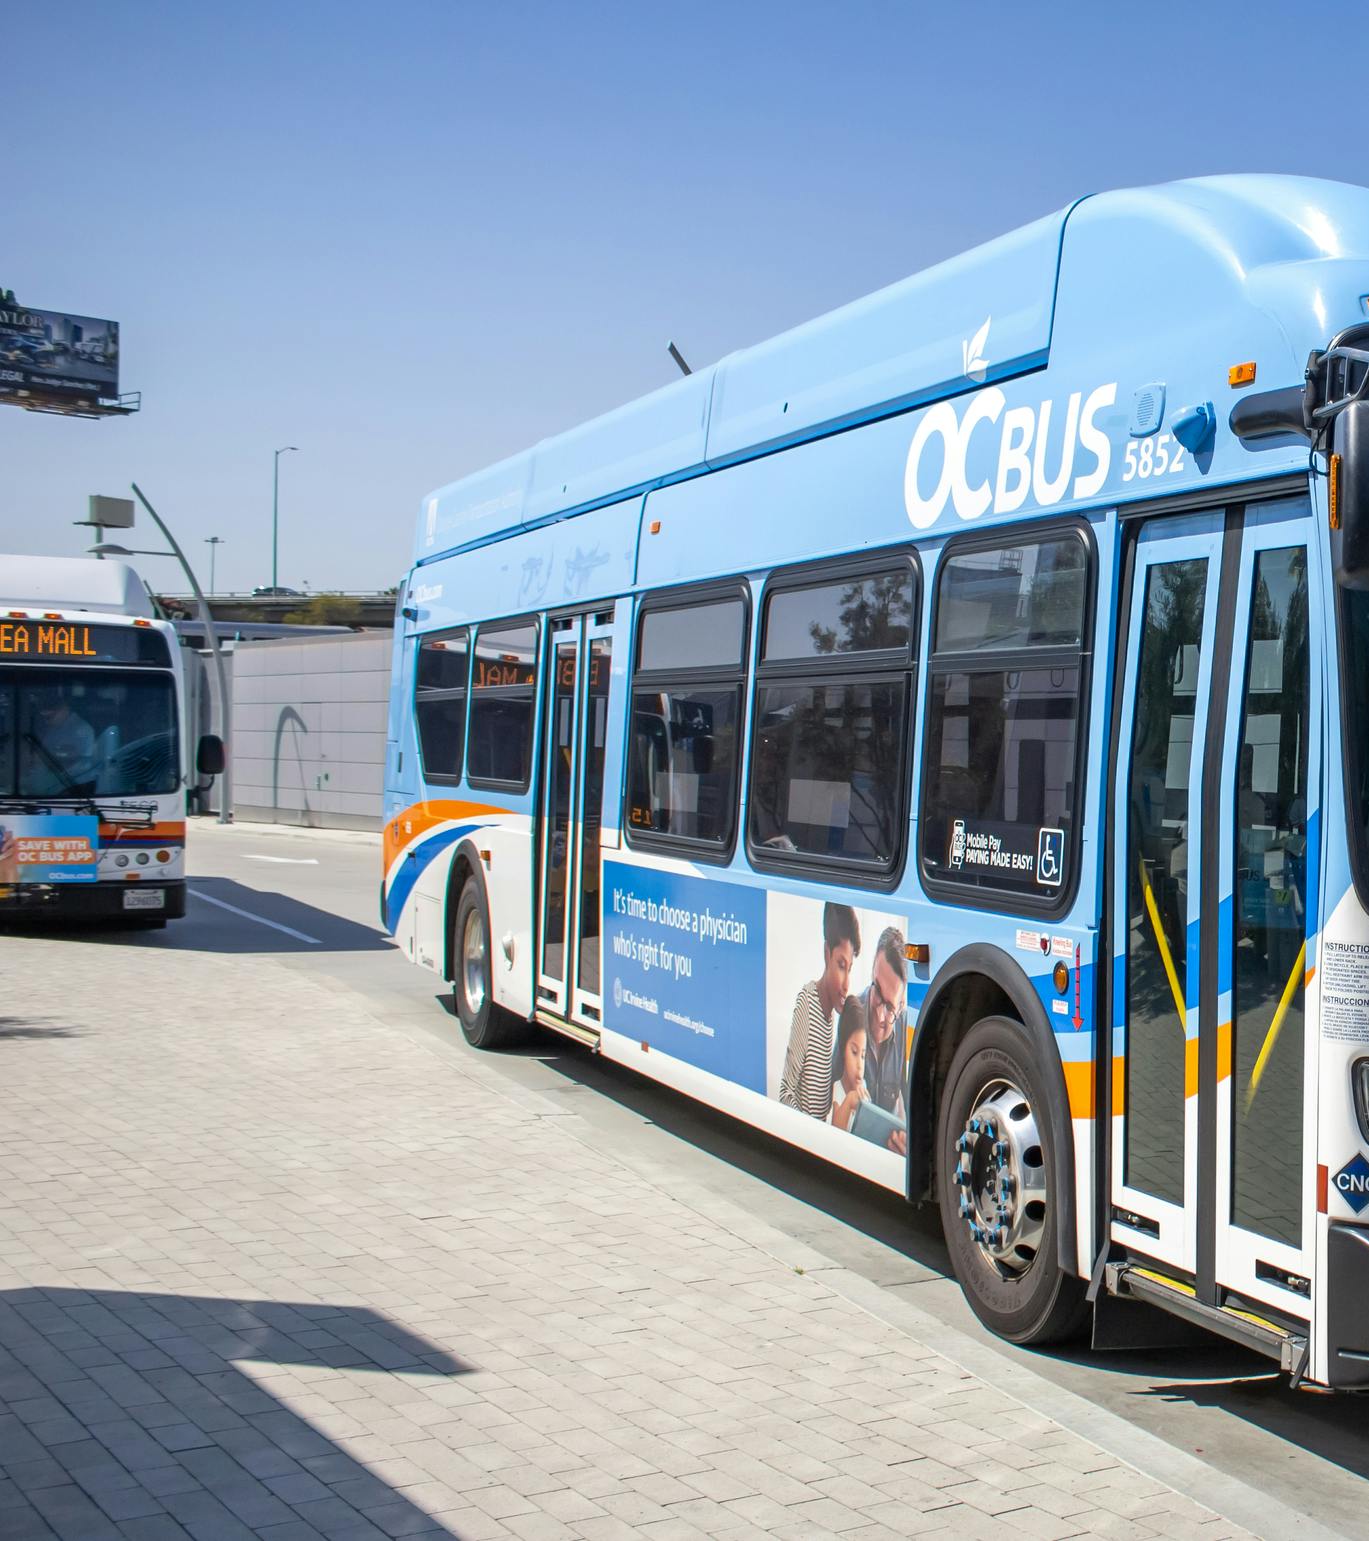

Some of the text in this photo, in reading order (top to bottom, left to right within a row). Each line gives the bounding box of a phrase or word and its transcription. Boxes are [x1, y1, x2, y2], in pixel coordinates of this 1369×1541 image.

[1122, 434, 1185, 482] 5852
[0, 624, 97, 656] EA MALL
[18, 840, 86, 850] SAVE WITH
[18, 851, 93, 861] OC BUS APP
[966, 833, 1001, 853] Mobile Pay
[965, 848, 1033, 870] PAYING MADE EASY!
[613, 888, 747, 945] It's time to choose a physician
[613, 930, 691, 980] who's right for you
